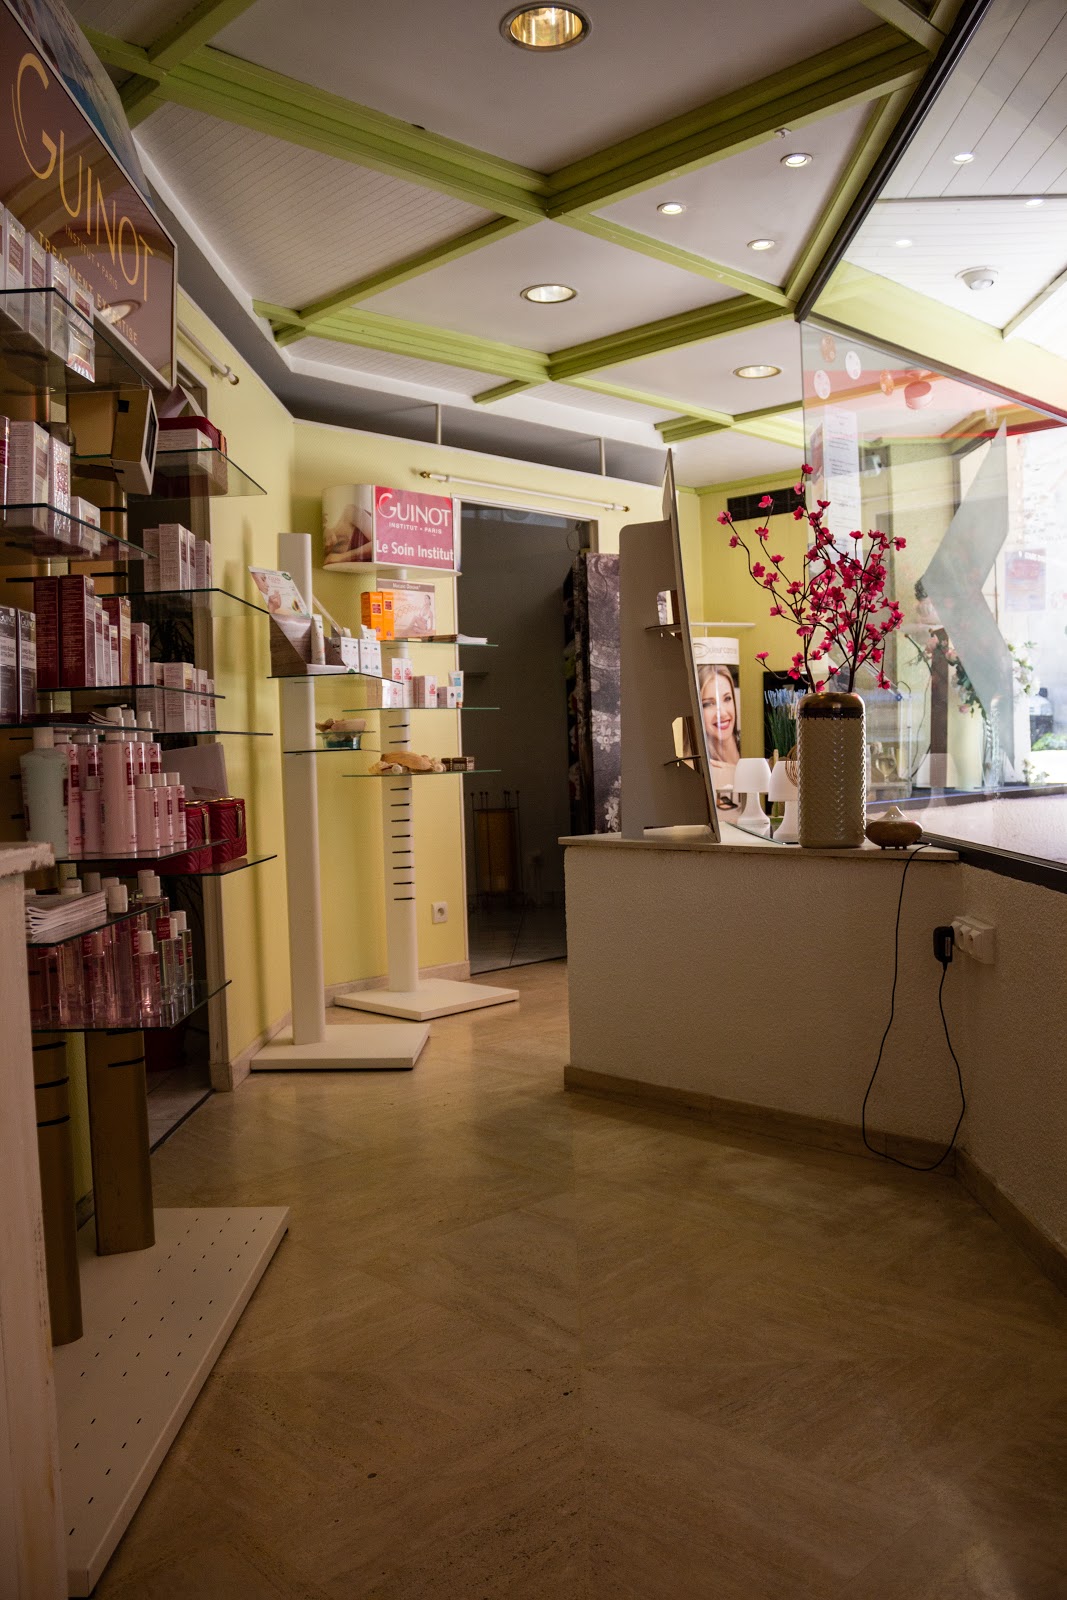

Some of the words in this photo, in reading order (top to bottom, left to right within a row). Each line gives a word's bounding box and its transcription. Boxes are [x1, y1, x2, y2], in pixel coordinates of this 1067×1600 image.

[11, 52, 154, 302] GUINOT
[38, 230, 94, 293] TREATMENT
[65, 223, 95, 264] INSTITUT
[101, 268, 118, 291] PARIS
[378, 492, 451, 527] GUINOT
[388, 521, 418, 531] INSTITUT
[424, 527, 442, 535] PARIS
[376, 539, 389, 553] Le
[391, 541, 414, 557] Soin
[417, 544, 454, 561] Institut
